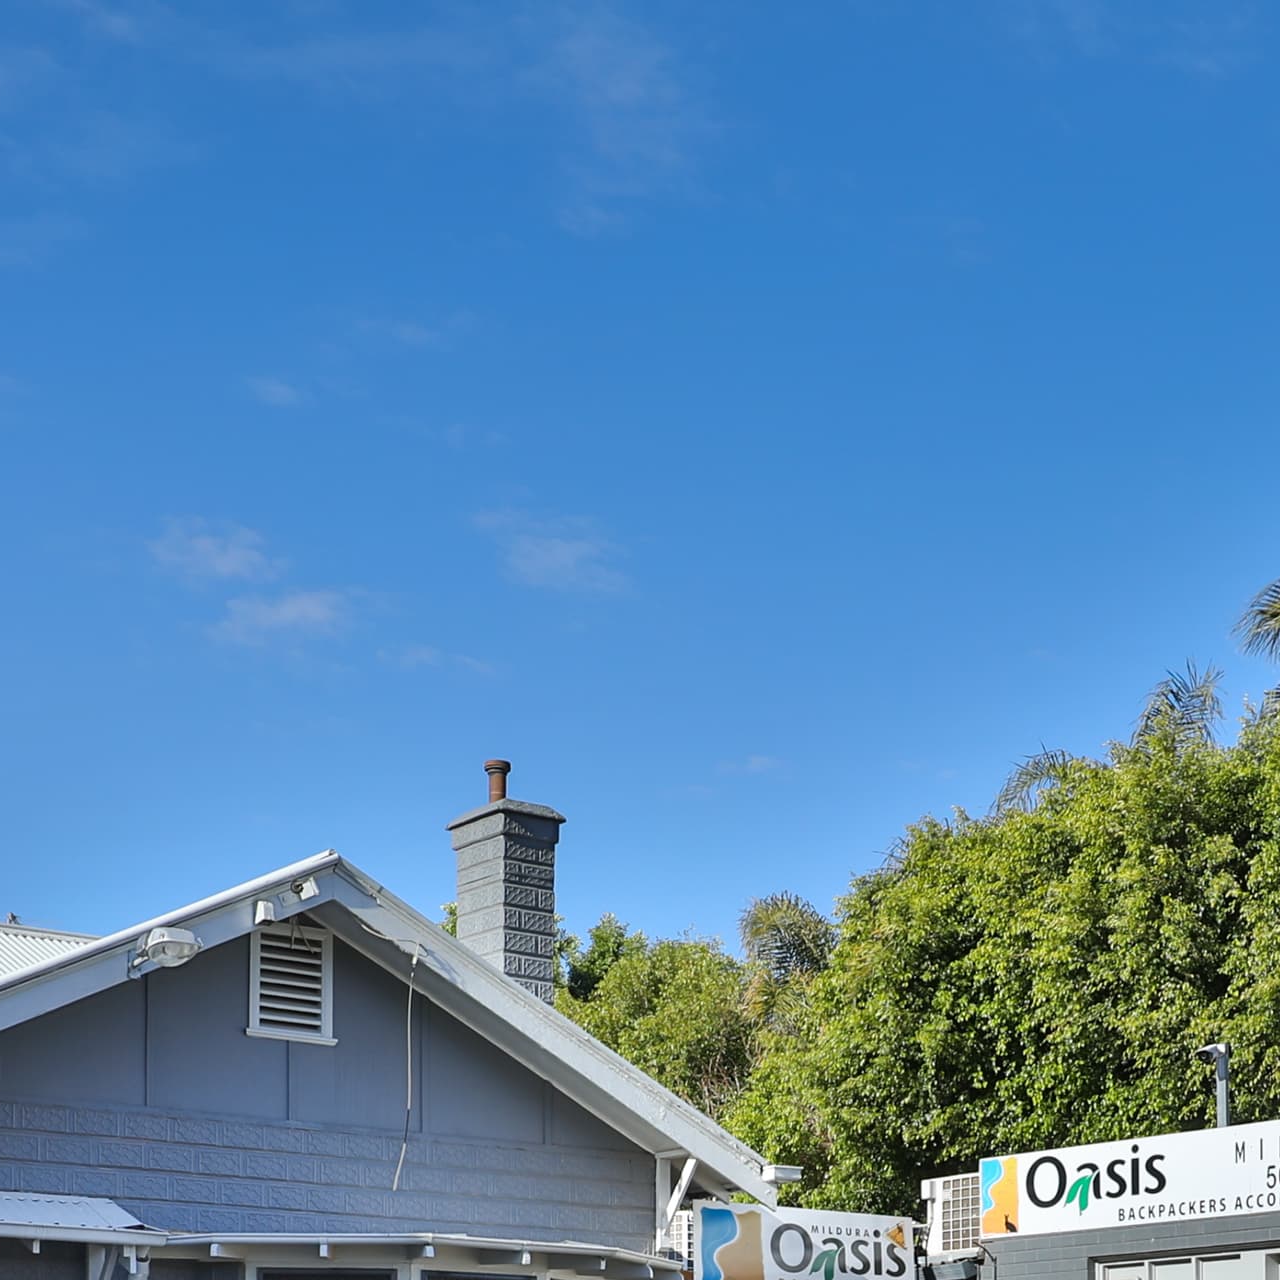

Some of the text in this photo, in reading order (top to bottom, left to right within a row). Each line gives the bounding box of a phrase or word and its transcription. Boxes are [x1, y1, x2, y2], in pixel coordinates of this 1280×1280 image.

[1026, 1144, 1167, 1214] Oasis
[1118, 1198, 1226, 1222] BACKPACKERS
[811, 1225, 870, 1237] MILDURA
